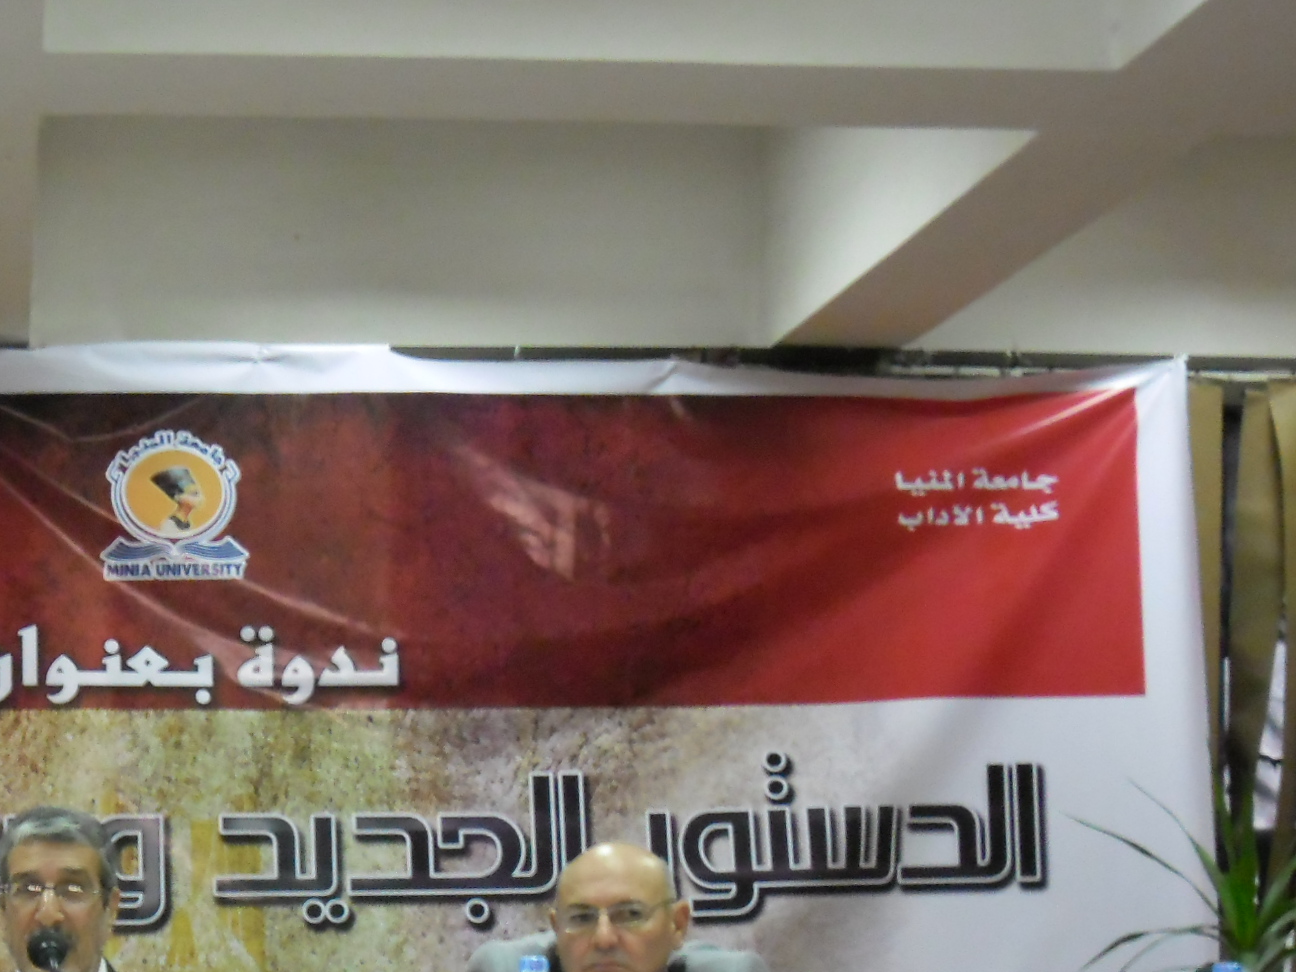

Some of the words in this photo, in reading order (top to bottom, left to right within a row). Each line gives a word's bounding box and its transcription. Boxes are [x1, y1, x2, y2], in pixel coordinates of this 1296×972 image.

[894, 469, 965, 497] المنيا
[971, 466, 1059, 494] جامعة
[990, 499, 1059, 530] كلية
[107, 564, 151, 577] MINIA
[156, 563, 243, 577] UNIVERSITY
[236, 625, 400, 705] ندوة
[212, 769, 586, 926] الجديد
